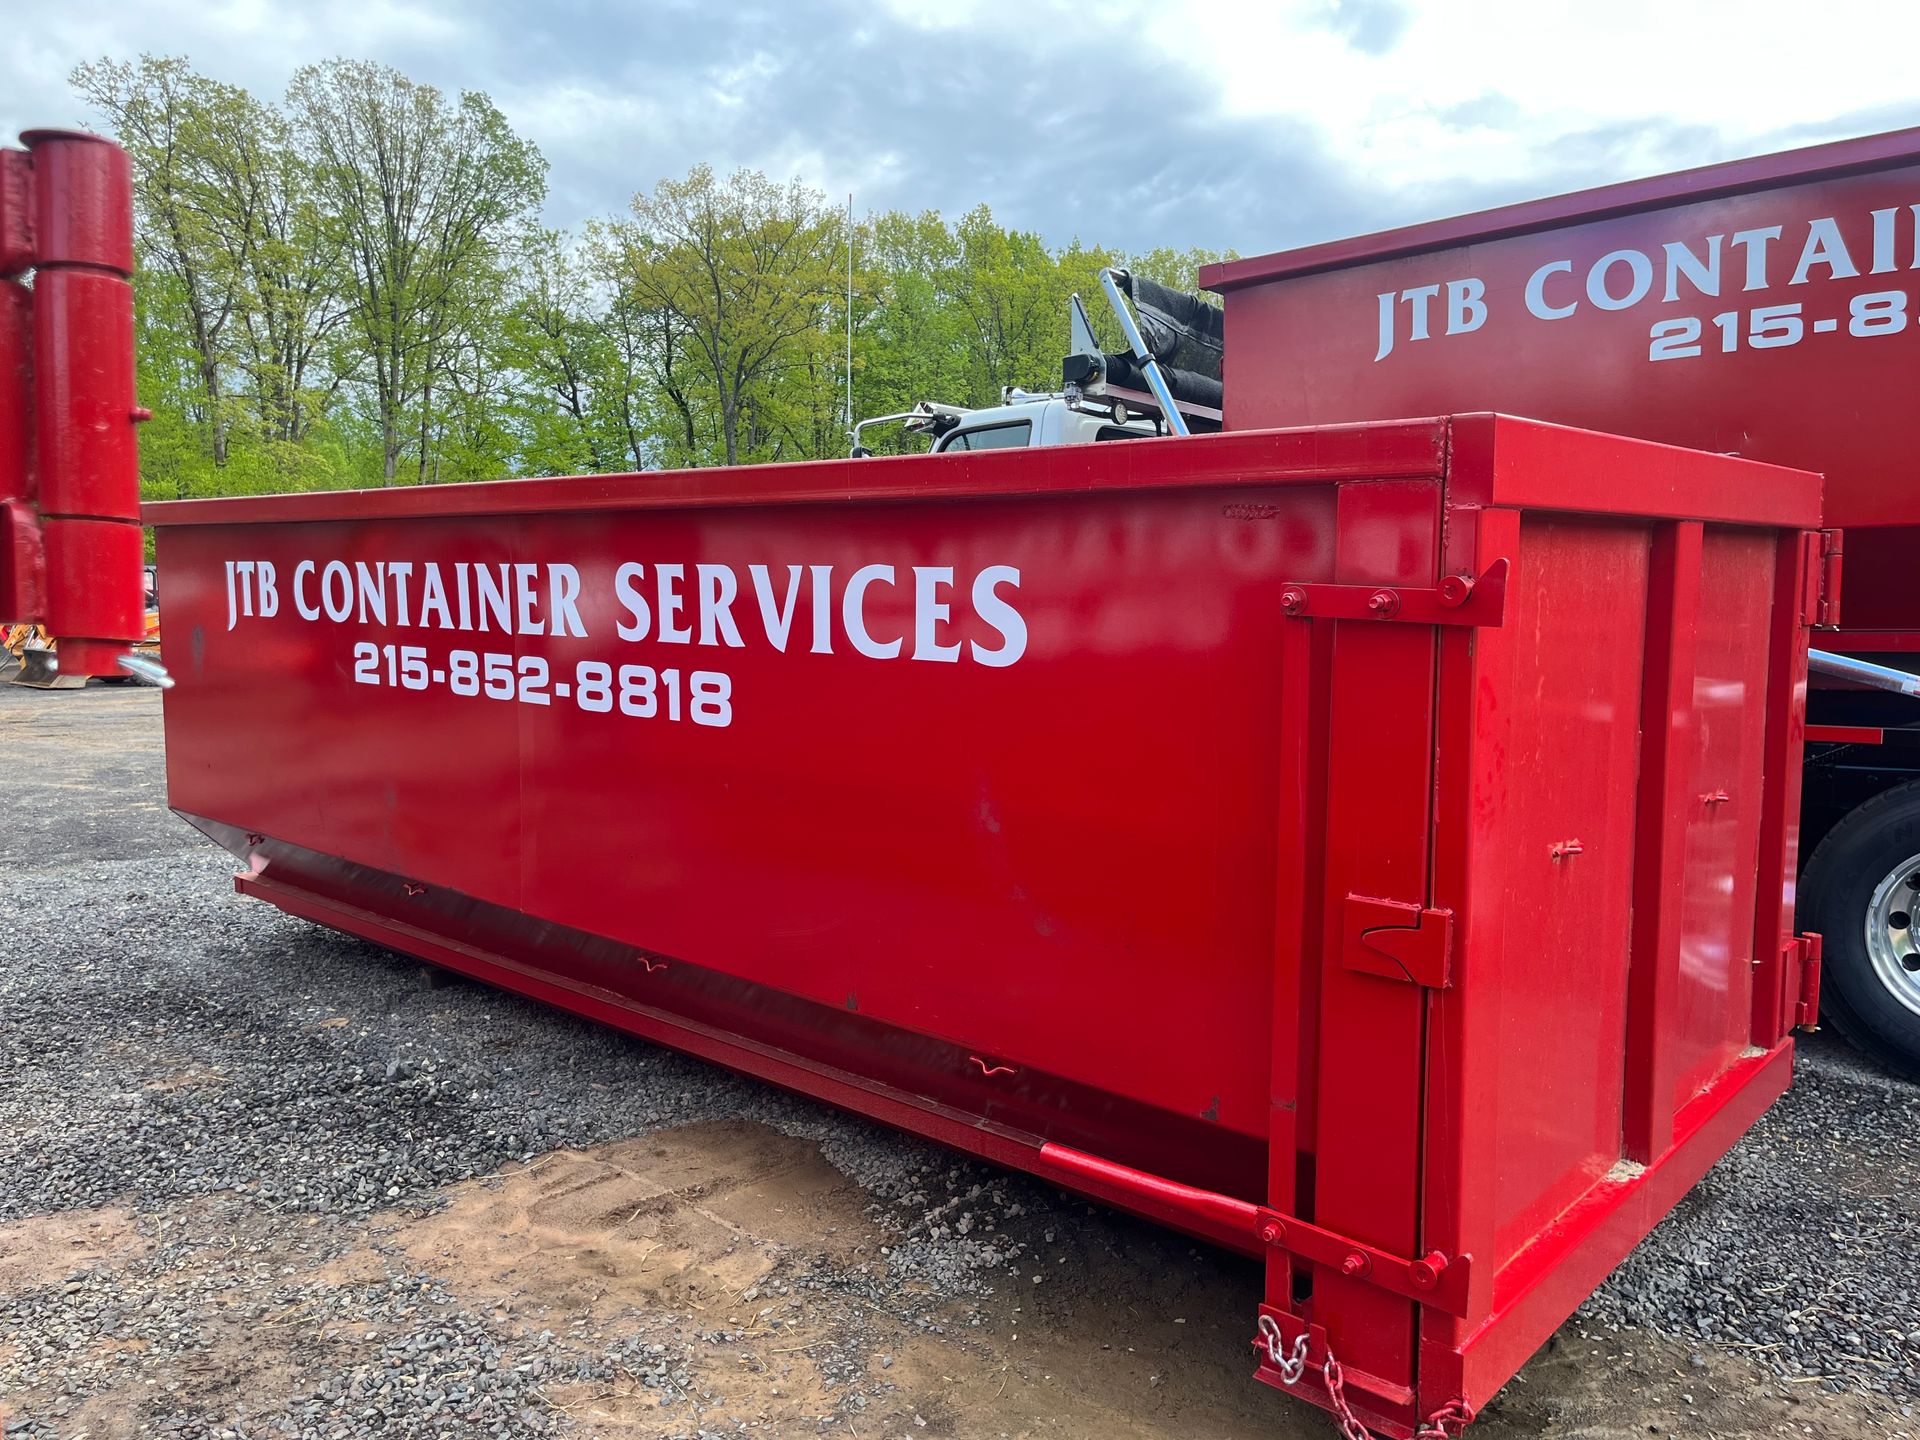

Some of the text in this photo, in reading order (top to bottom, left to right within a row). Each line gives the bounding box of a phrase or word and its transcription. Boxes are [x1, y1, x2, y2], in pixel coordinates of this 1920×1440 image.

[1373, 203, 1920, 363] JTB CONTAI
[1648, 290, 1920, 362] 215-8
[224, 559, 1028, 668] JTB CONTAINER SERVICES
[353, 641, 733, 728] 215-852-8818
